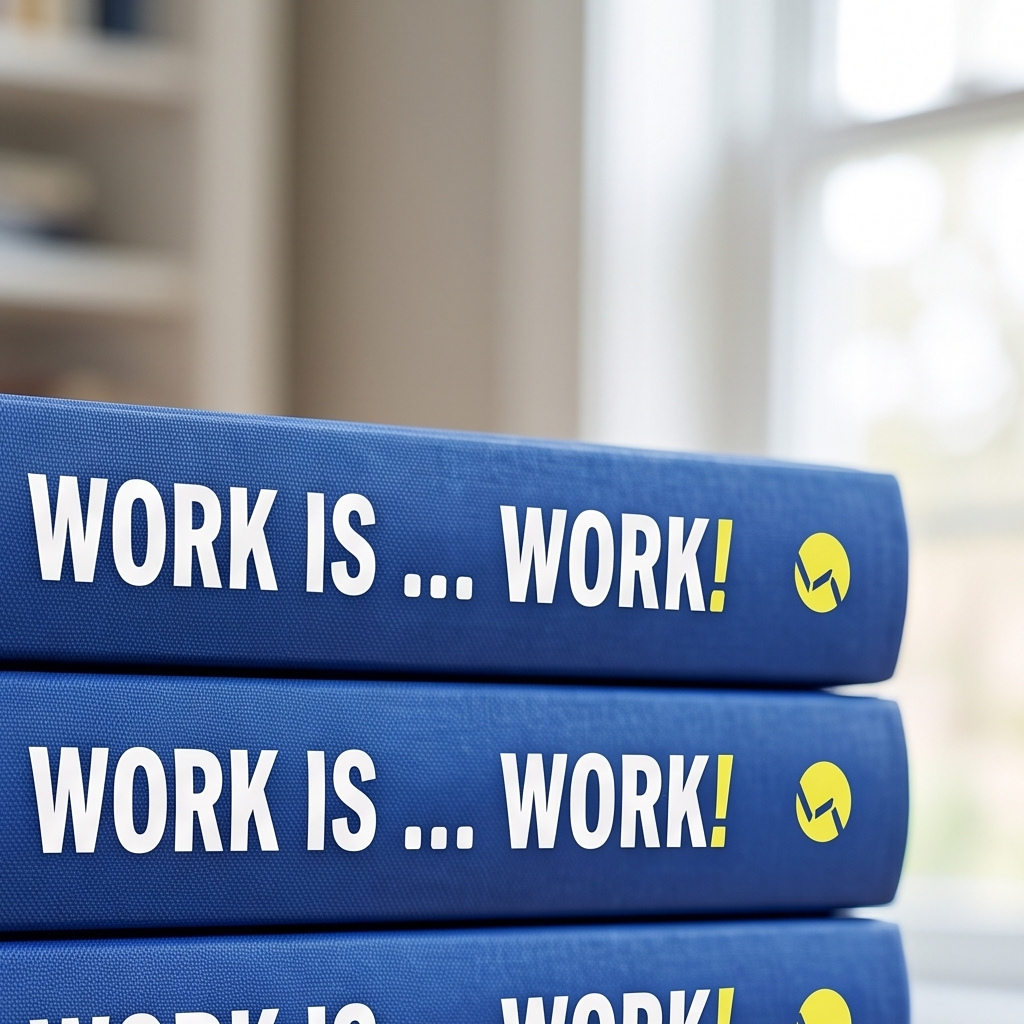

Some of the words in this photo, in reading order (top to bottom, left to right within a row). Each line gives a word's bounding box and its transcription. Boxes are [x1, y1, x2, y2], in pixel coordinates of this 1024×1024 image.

[28, 473, 278, 590] WORK
[306, 492, 375, 596] IS
[500, 505, 733, 612] WORK!
[29, 747, 279, 853] WORK
[307, 749, 376, 851] IS
[500, 753, 733, 849] WORK!
